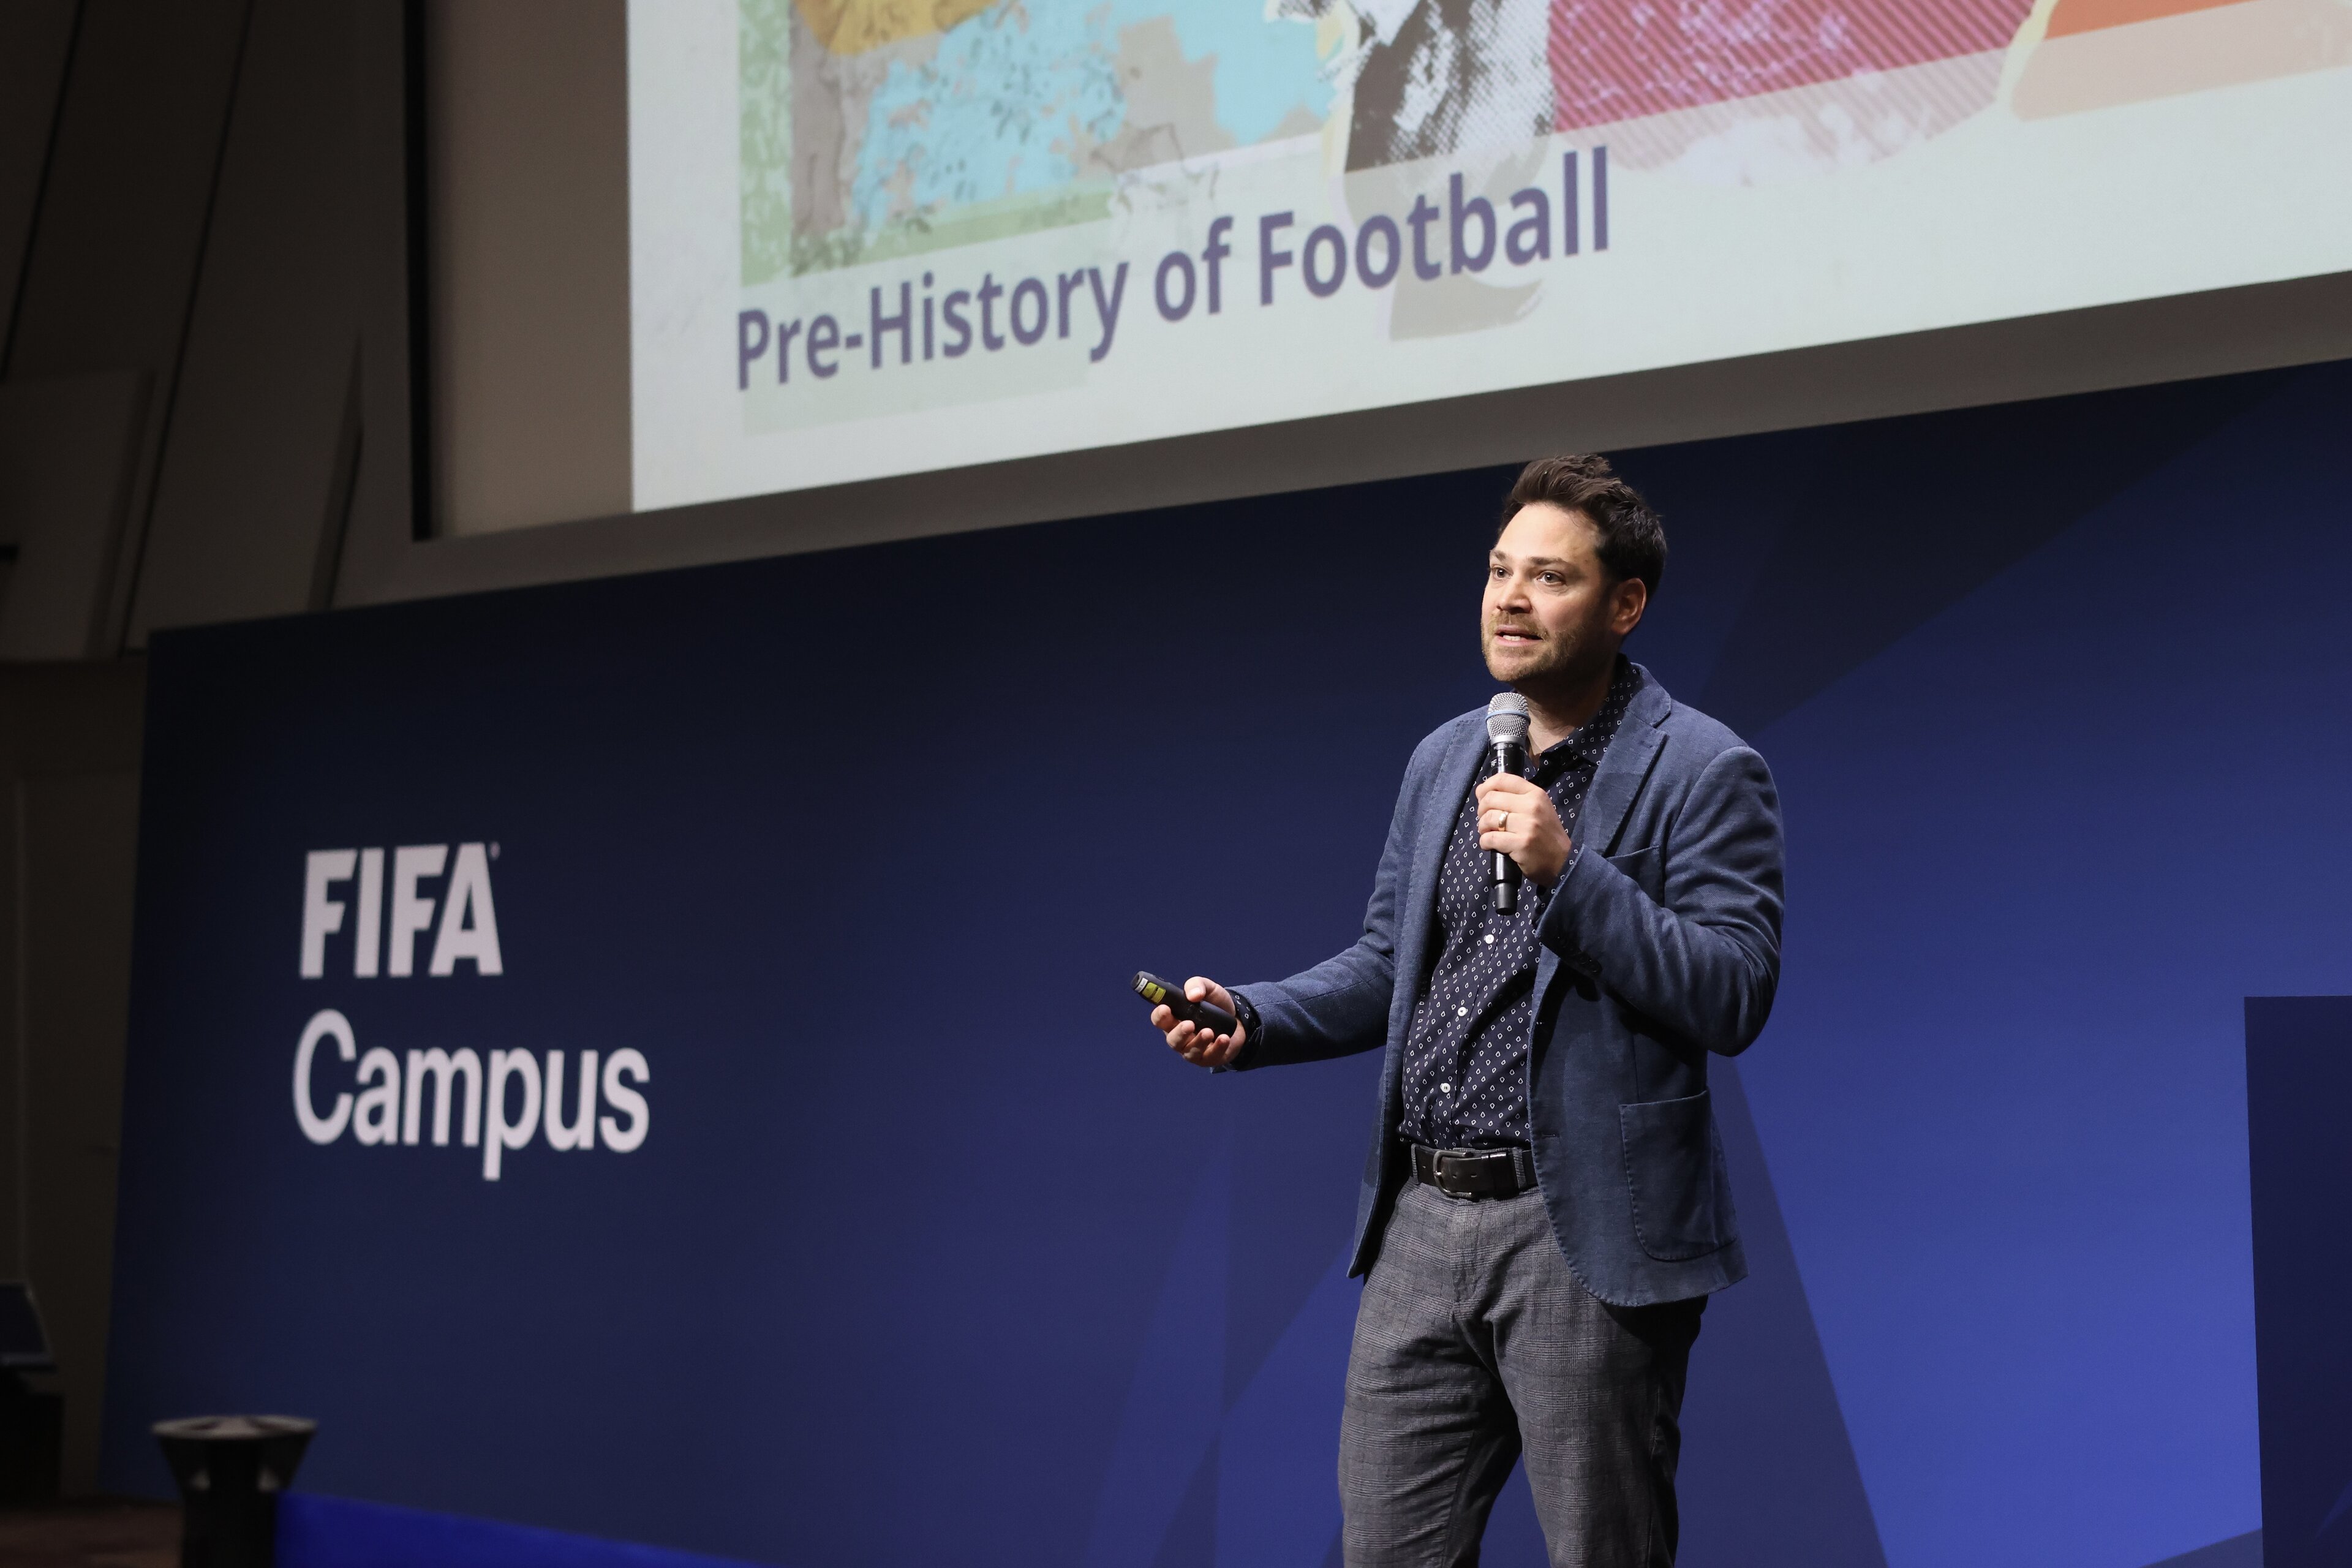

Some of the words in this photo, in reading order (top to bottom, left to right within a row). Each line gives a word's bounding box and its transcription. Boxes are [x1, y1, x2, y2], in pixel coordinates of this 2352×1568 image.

[738, 262, 1129, 391] Pre-History
[1154, 216, 1233, 322] of
[1259, 146, 1609, 306] Football
[300, 842, 503, 978] FIFA
[292, 1008, 650, 1181] Campus
